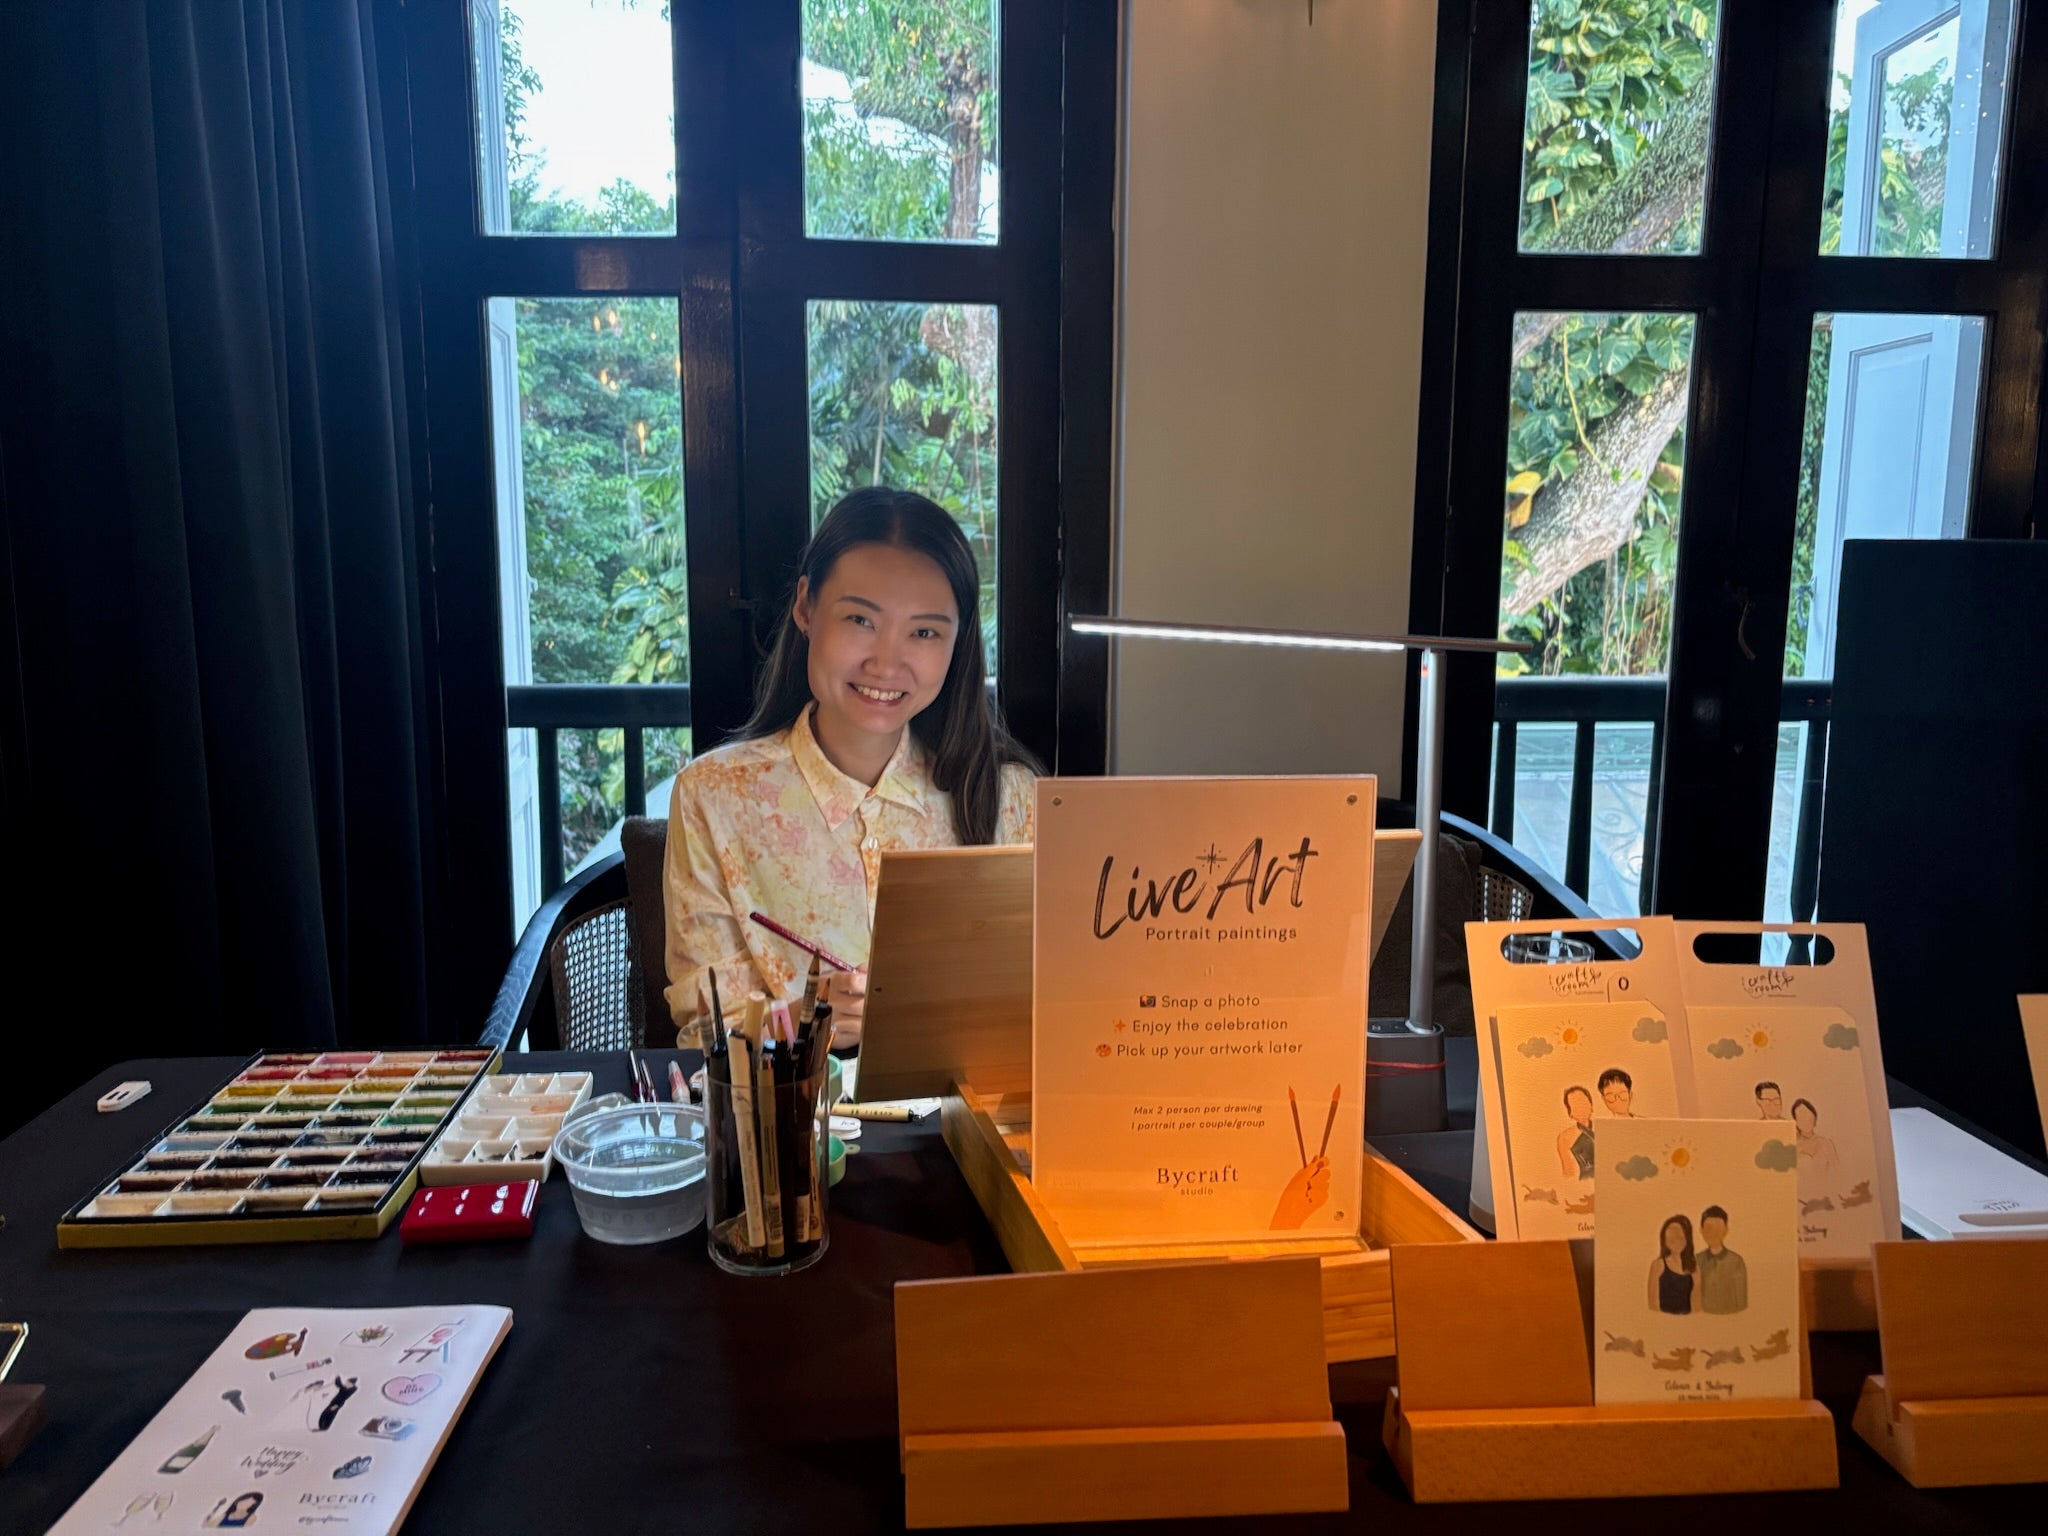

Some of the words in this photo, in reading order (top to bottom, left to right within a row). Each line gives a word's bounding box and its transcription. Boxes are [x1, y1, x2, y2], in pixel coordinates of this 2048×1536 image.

[1093, 854, 1207, 940] Live
[1206, 836, 1319, 921] Art
[1145, 926, 1211, 941] Portrait
[1217, 925, 1298, 943] paintings
[1160, 994, 1199, 1012] Snap
[1203, 997, 1213, 1008] a
[1218, 994, 1261, 1010] photo
[1131, 1018, 1172, 1035] Enjoy
[1176, 1018, 1200, 1032] the
[1204, 1017, 1289, 1032] celebration
[1116, 1043, 1146, 1058] Pick
[1151, 1046, 1169, 1060] up
[1173, 1045, 1206, 1059] your
[1208, 1042, 1264, 1056] artwork
[1268, 1041, 1303, 1055] later
[1133, 1106, 1154, 1116] Max
[1157, 1106, 1164, 1115] 2
[1166, 1106, 1201, 1117] person
[1203, 1106, 1221, 1115] per
[1223, 1103, 1264, 1115] drawing
[1137, 1120, 1176, 1132] portrait
[1178, 1121, 1197, 1131] per
[1199, 1118, 1266, 1131] couple/group
[1156, 1164, 1240, 1189] Bycraft
[1180, 1186, 1215, 1196] studio
[259, 1445, 304, 1461] Happy
[239, 1455, 297, 1477] Wedding
[298, 1491, 377, 1506] Bycraft
